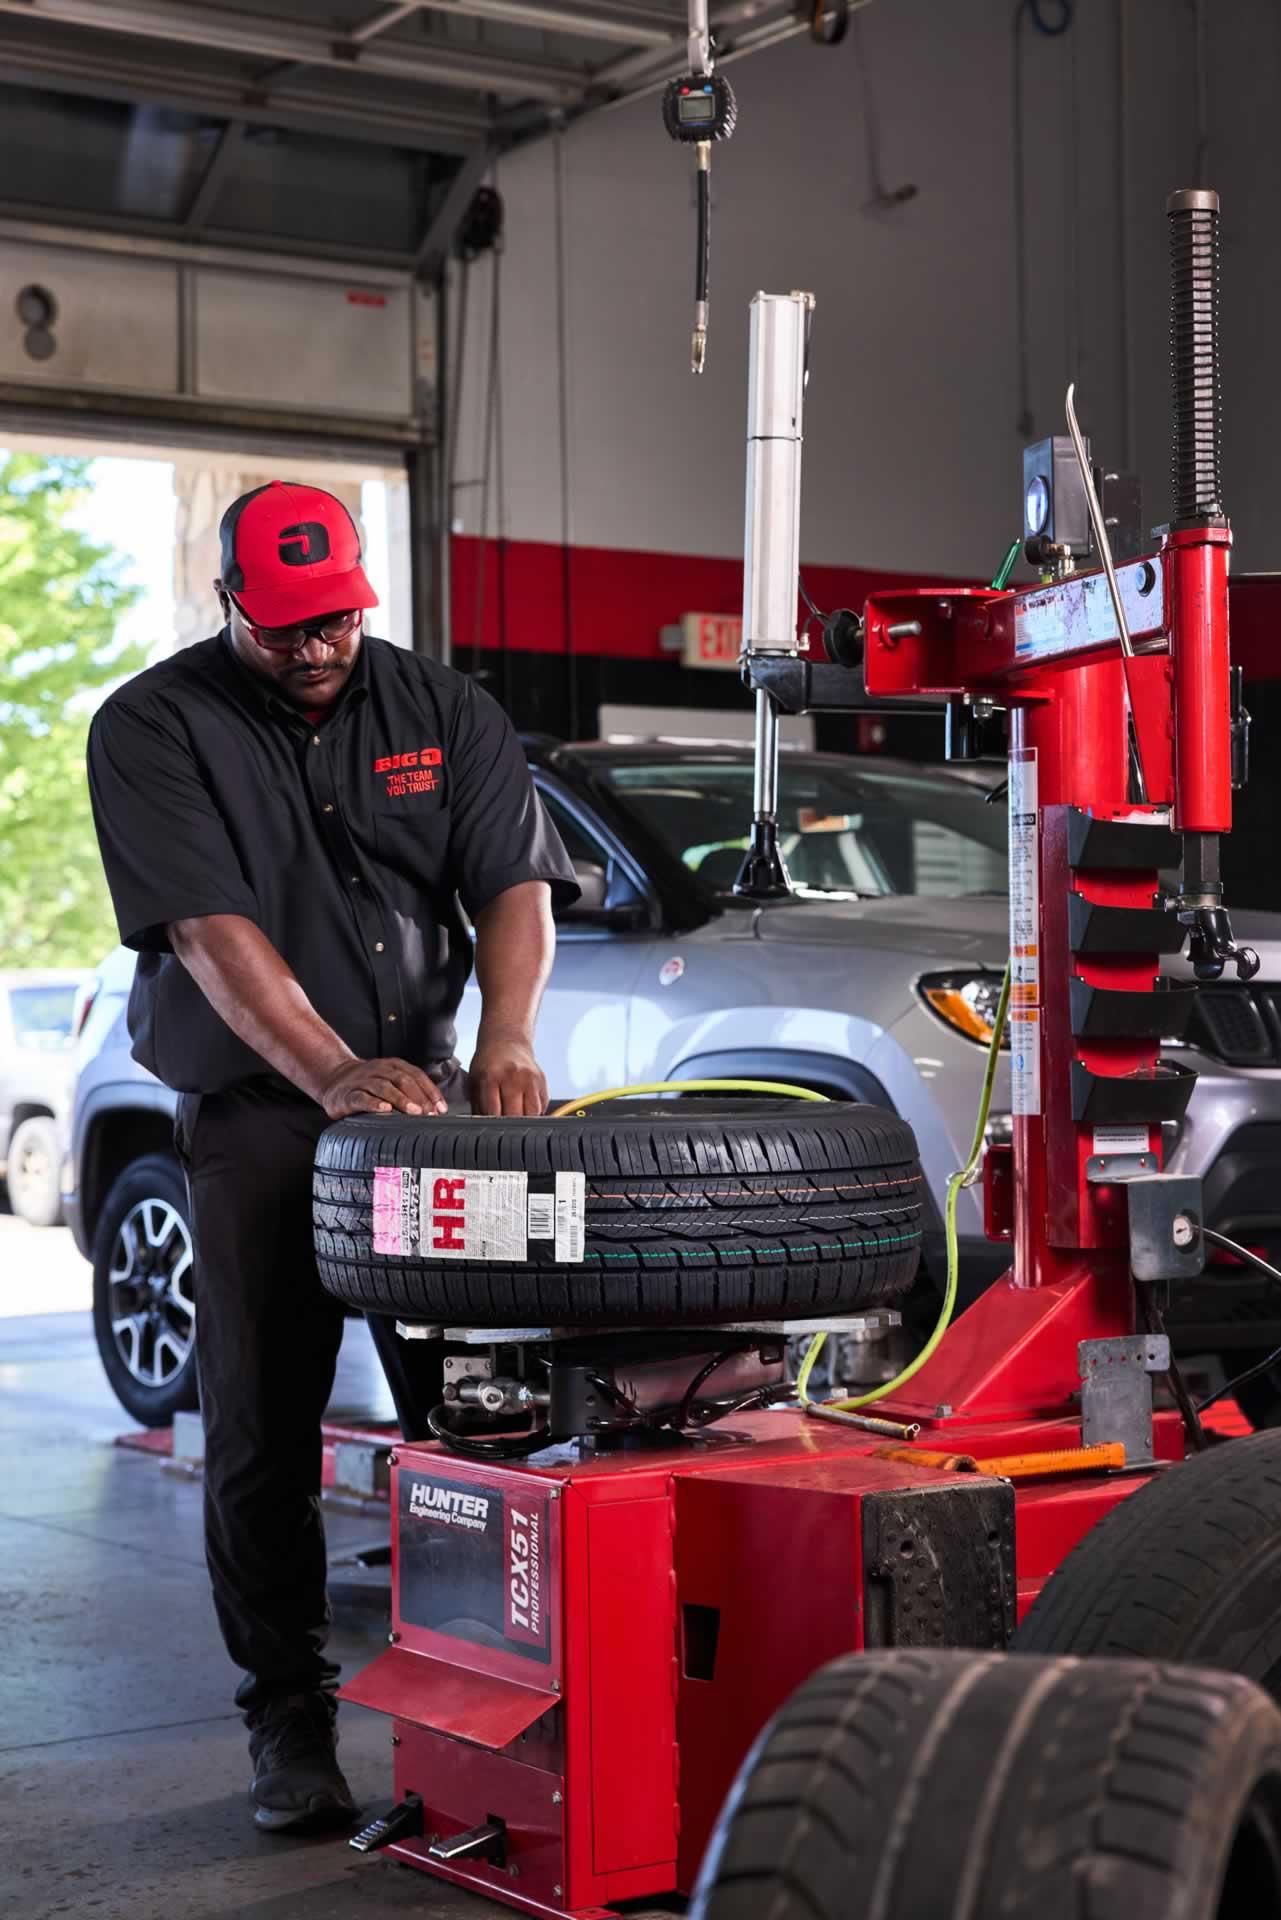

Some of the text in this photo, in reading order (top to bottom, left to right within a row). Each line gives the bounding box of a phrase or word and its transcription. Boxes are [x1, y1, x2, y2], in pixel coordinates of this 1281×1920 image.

[699, 617, 743, 659] EXI
[374, 752, 418, 772] BIG
[387, 769, 432, 785] THE TEAM
[386, 780, 440, 797] YOU TRUST
[433, 1177, 466, 1250] HR
[409, 1503, 487, 1532] Engineering Company
[410, 1483, 489, 1518] HUNTER
[511, 1508, 529, 1628] TCX51
[531, 1512, 540, 1634] PROFESSIONAL
